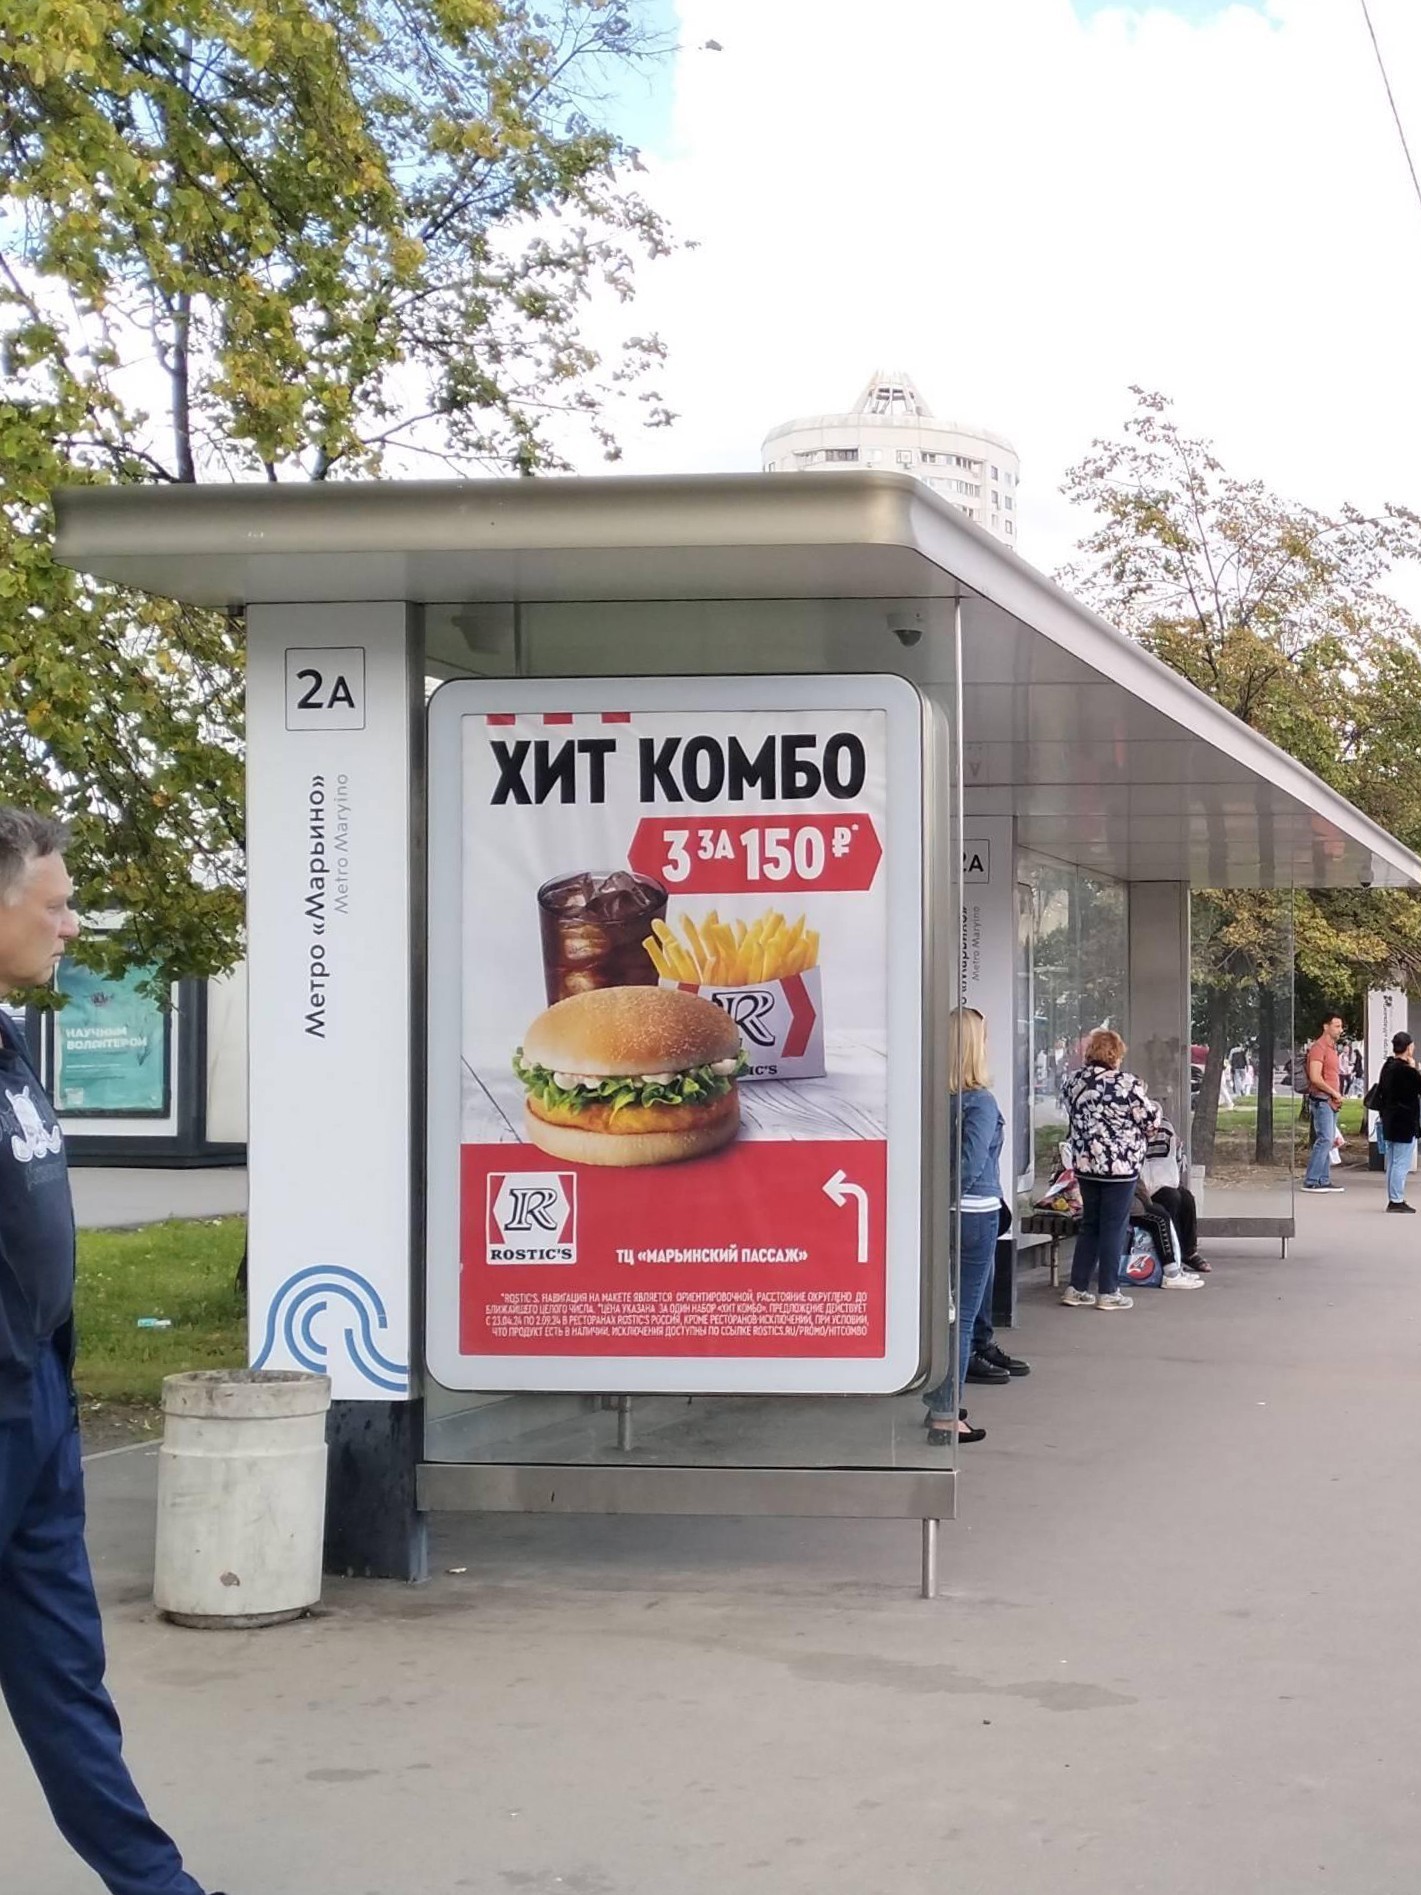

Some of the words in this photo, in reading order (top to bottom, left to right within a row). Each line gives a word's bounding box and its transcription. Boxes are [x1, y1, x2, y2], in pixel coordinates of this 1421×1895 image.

[489, 738, 617, 805] ХИТ
[638, 732, 867, 804] КОМБО
[334, 773, 351, 853] Maryino
[304, 774, 330, 937] «Марьино»
[661, 829, 692, 883] 3
[696, 828, 736, 860] ЗА
[334, 857, 349, 915] Metro
[304, 944, 330, 1039] Метро
[490, 1248, 573, 1261] ROSTIC'S
[616, 1249, 635, 1265] ТЦ
[637, 1243, 738, 1263] «МАРЬИНСКИЙ
[741, 1248, 809, 1263] ПАССАЖ»
[539, 1304, 567, 1315] ЦЕЛОГО
[621, 1303, 656, 1314] УКАЗАНА
[659, 1303, 668, 1313] ЗА
[669, 1303, 691, 1314] ОДИН
[691, 1303, 716, 1313] НАБОР
[769, 1303, 824, 1314] ПРЕДЛОЖЕНИЕ
[825, 1302, 868, 1313] ДЕЙСТВУЕТ
[589, 1292, 600, 1302] НА
[601, 1292, 632, 1302] МАКЕТЕ
[633, 1292, 673, 1302] ЯВЛЯЕТСЯ
[757, 1291, 806, 1302] РАССТОЯНИЕ
[808, 1291, 852, 1302] ОКРУГЛЕНО
[855, 1291, 868, 1303] ДО
[492, 1327, 508, 1337] ЧТО
[509, 1327, 543, 1338] ПРОДУКТ
[545, 1326, 564, 1337] ЕСТЬ
[565, 1326, 571, 1336] В
[612, 1326, 664, 1336] ИСКЛЮЧЕНИЯ
[665, 1326, 706, 1337] ДОСТУПНЫ
[708, 1326, 720, 1336] ПО
[721, 1326, 751, 1336] ССЫЛКЕ
[523, 1315, 535, 1325] ПО
[562, 1315, 568, 1325] В
[569, 1315, 616, 1325] РЕСТОРАНАХ
[684, 1314, 708, 1324] КРОМЕ
[815, 1314, 831, 1324] ПРИ
